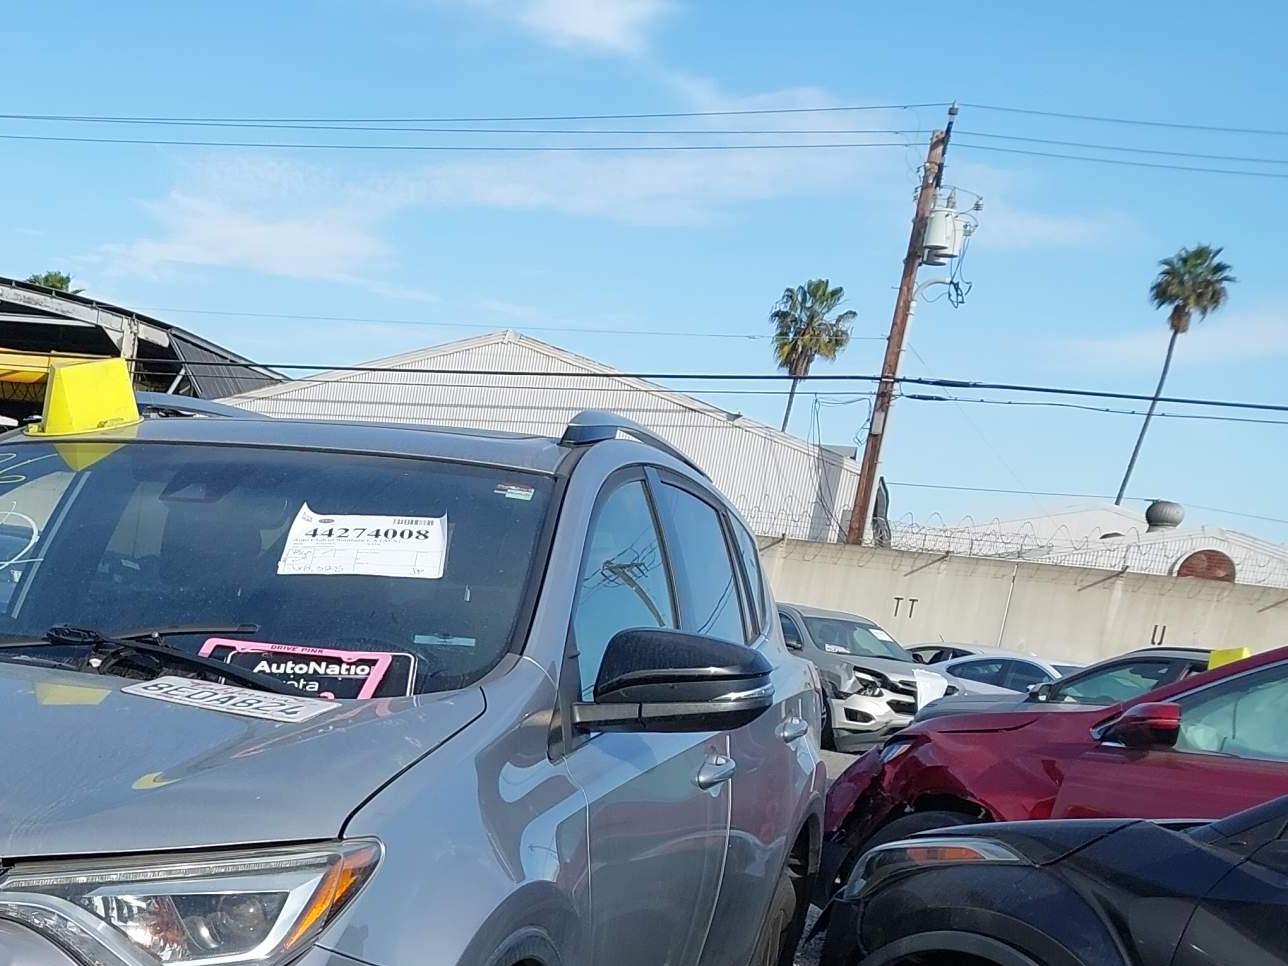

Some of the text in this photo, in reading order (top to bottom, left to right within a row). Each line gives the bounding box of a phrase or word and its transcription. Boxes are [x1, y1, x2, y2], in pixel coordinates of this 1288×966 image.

[304, 527, 430, 541] 44274008
[270, 644, 298, 652] DRIVE
[253, 660, 374, 676] AutoNatio
